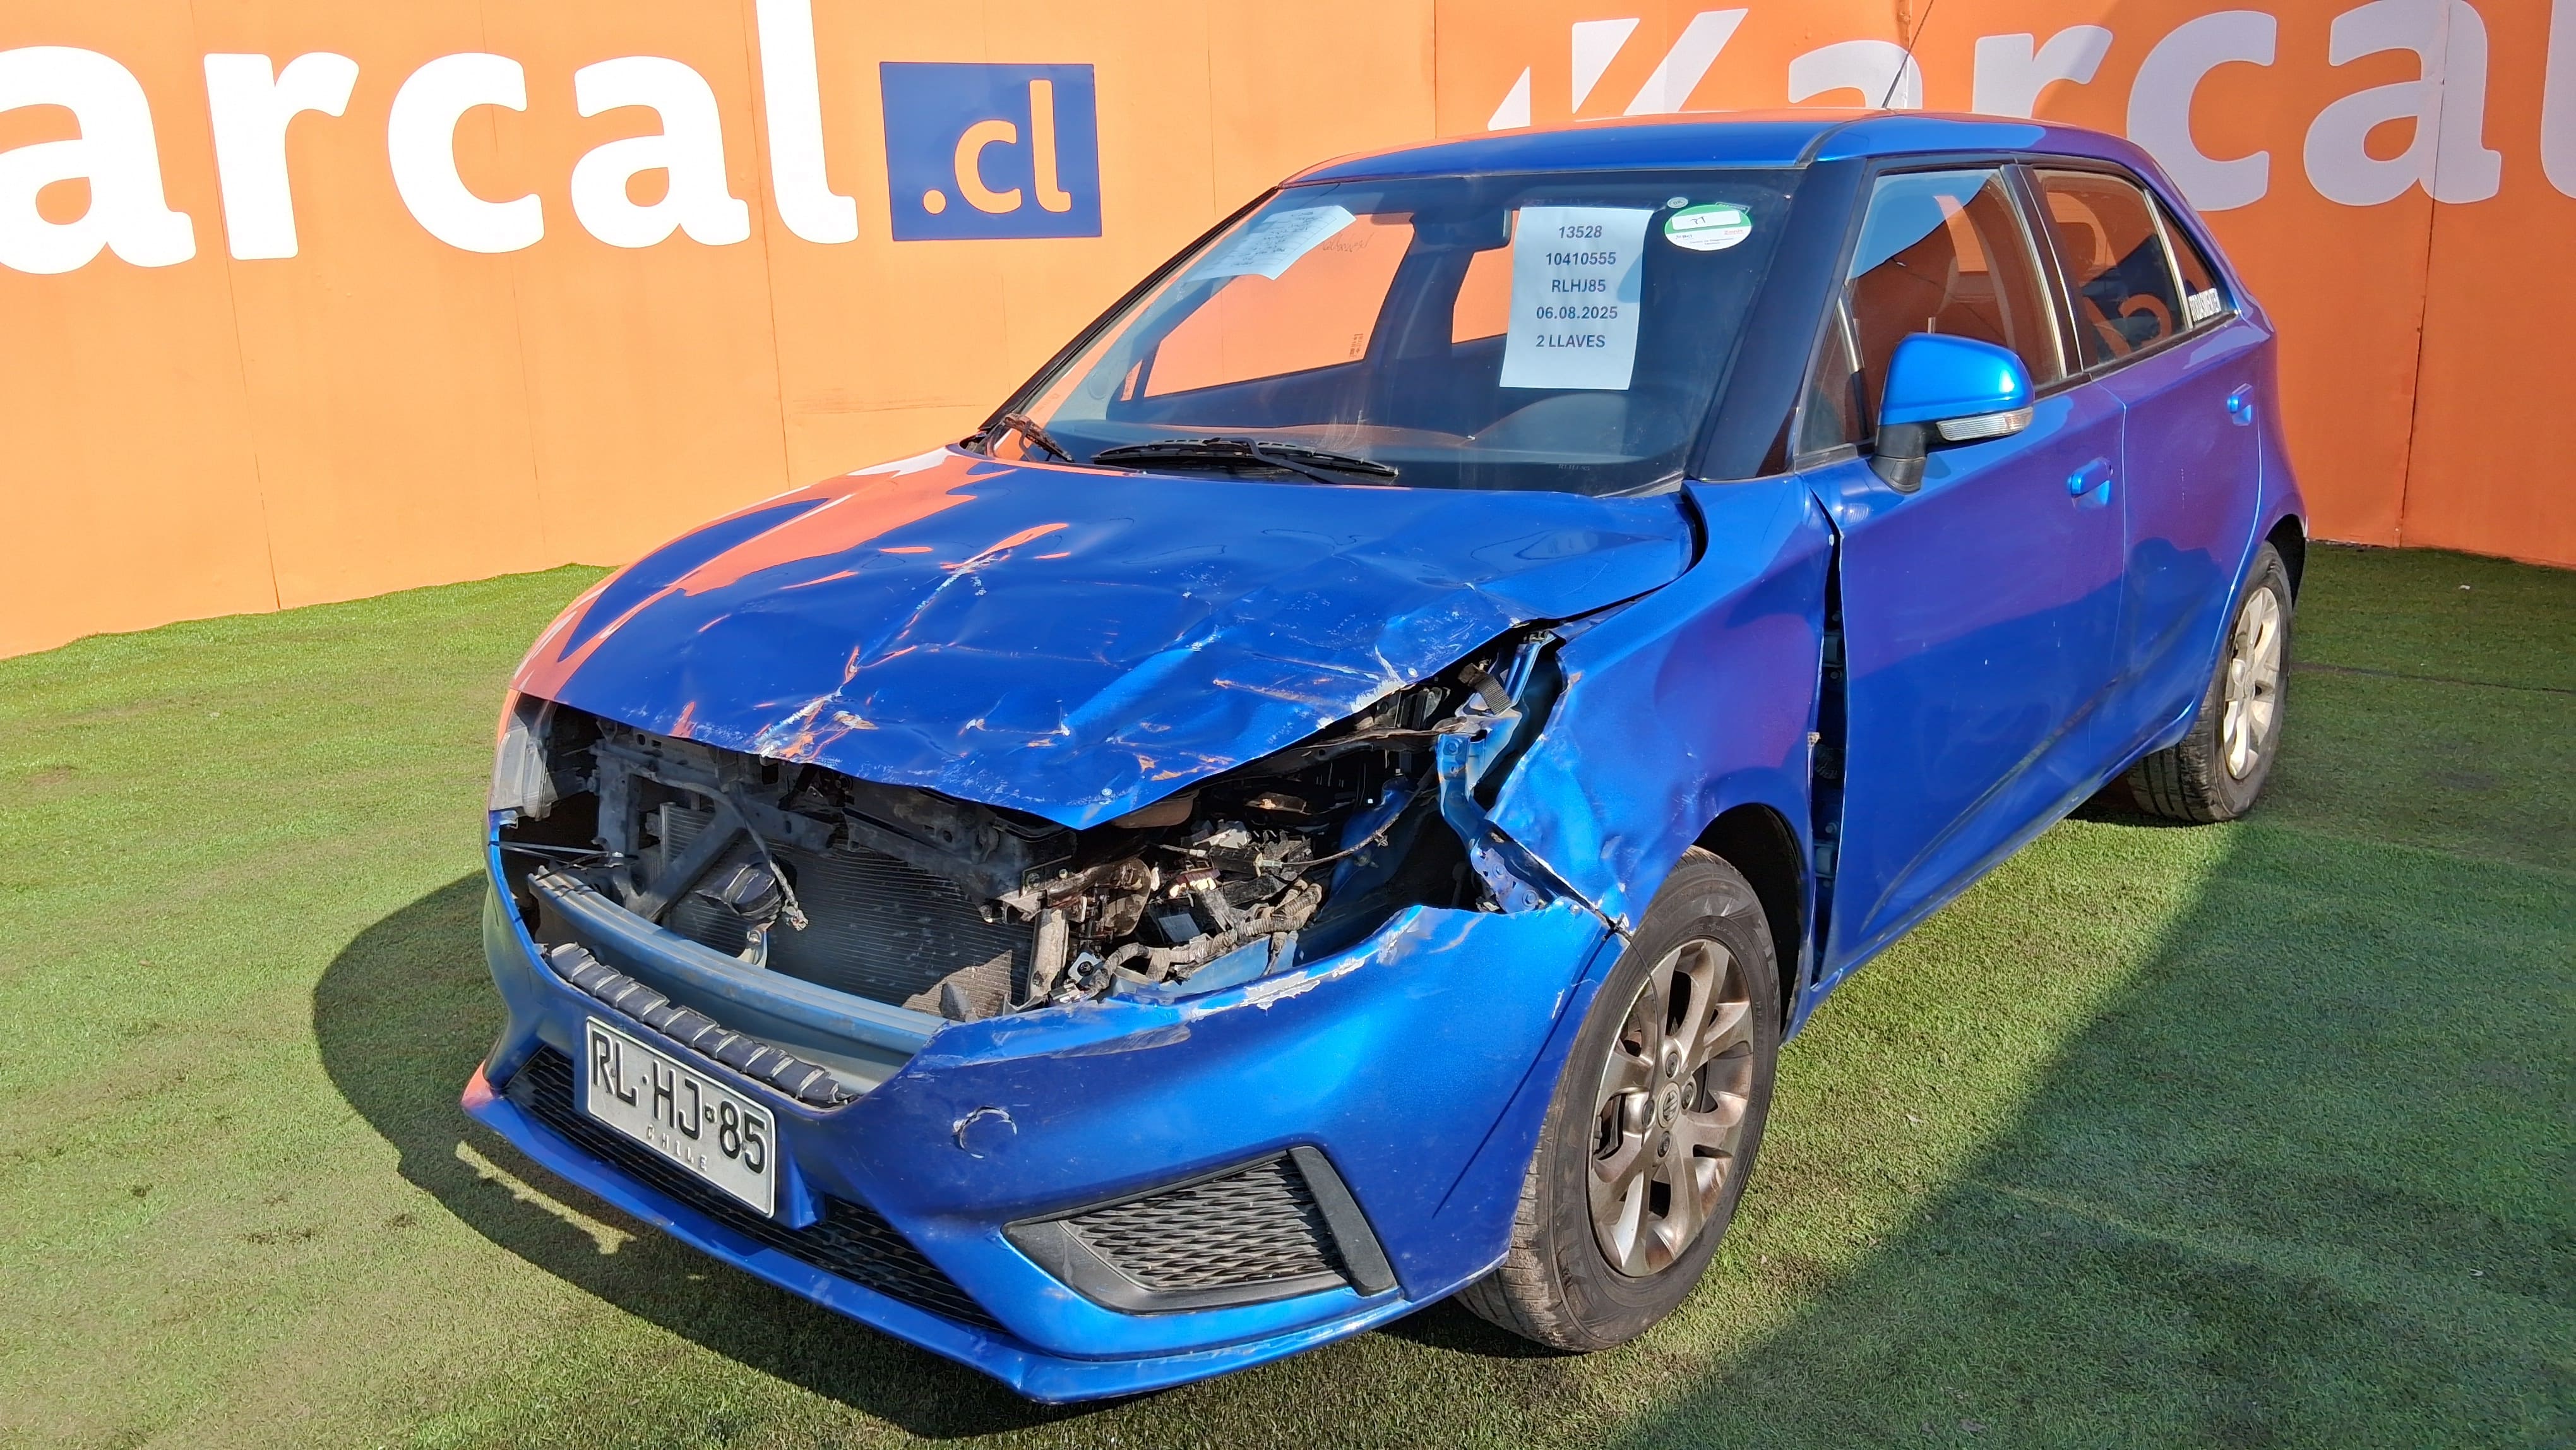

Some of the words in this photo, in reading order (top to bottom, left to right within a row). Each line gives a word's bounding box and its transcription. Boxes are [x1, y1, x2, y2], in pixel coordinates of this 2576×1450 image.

[1558, 225, 1602, 239] 13528
[1546, 251, 1616, 266] 10410555
[1551, 279, 1606, 293] RLHJ85
[1535, 306, 1618, 320] 06.08.2025
[1535, 335, 1545, 348] 2
[1549, 335, 1606, 348] LLAVES
[647, 1123, 708, 1173] CHILE
